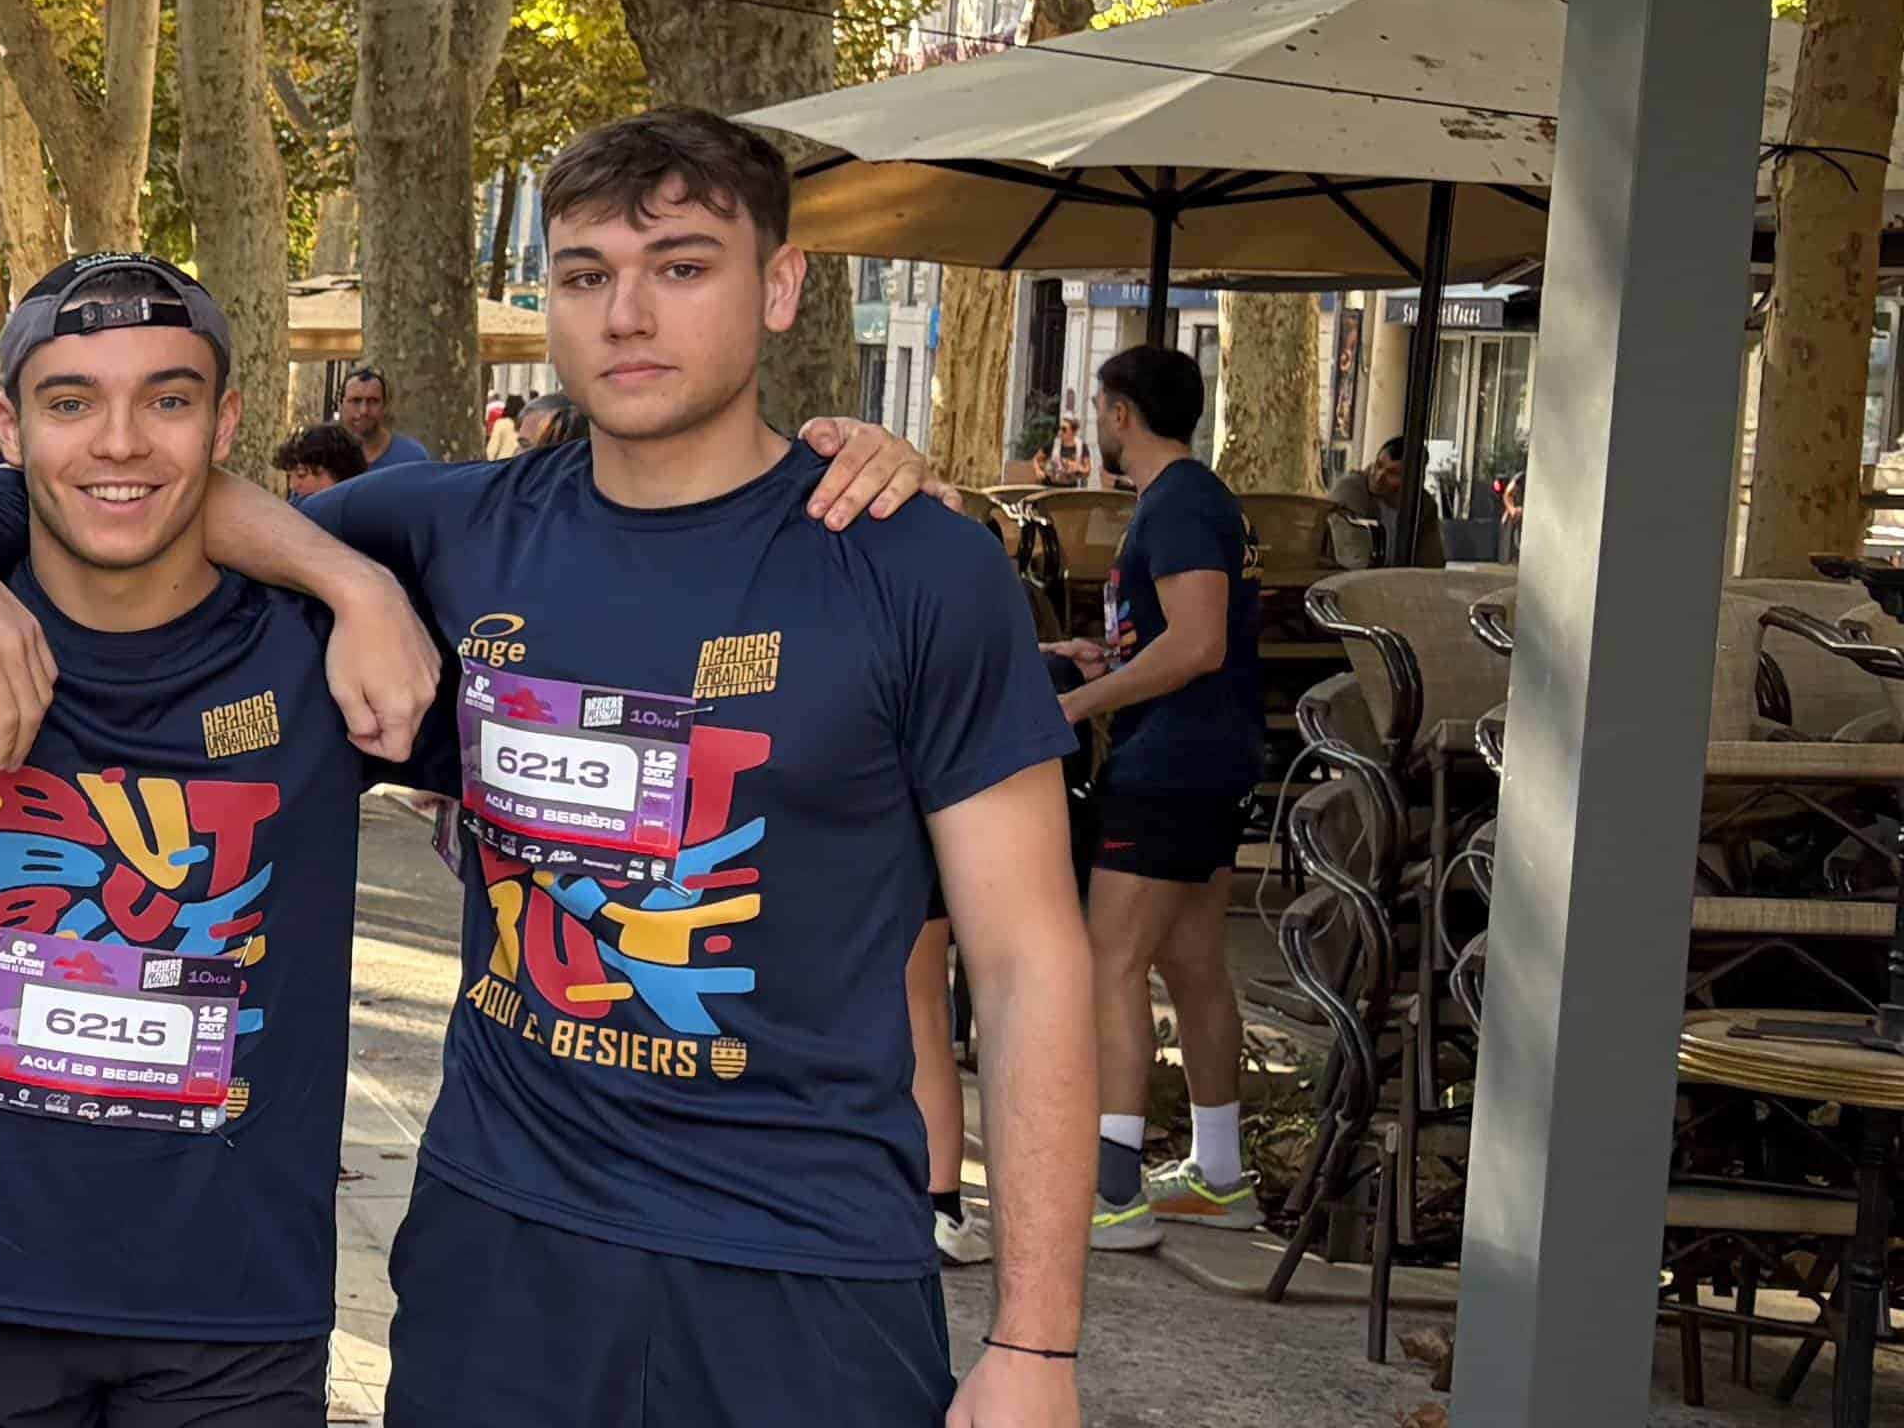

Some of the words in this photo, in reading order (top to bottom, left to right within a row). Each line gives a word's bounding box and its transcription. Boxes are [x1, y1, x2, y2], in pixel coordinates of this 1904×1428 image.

[497, 745, 610, 789] 6213
[643, 749, 677, 766] 12
[485, 792, 513, 813] AQUÍ
[515, 803, 537, 819] ES
[46, 1007, 166, 1047] 6215
[199, 1006, 228, 1023] 12
[466, 974, 522, 1028] AQUI
[551, 1019, 698, 1079] BESIERS
[20, 1053, 67, 1072] AQUÍ
[71, 1063, 97, 1077] ES
